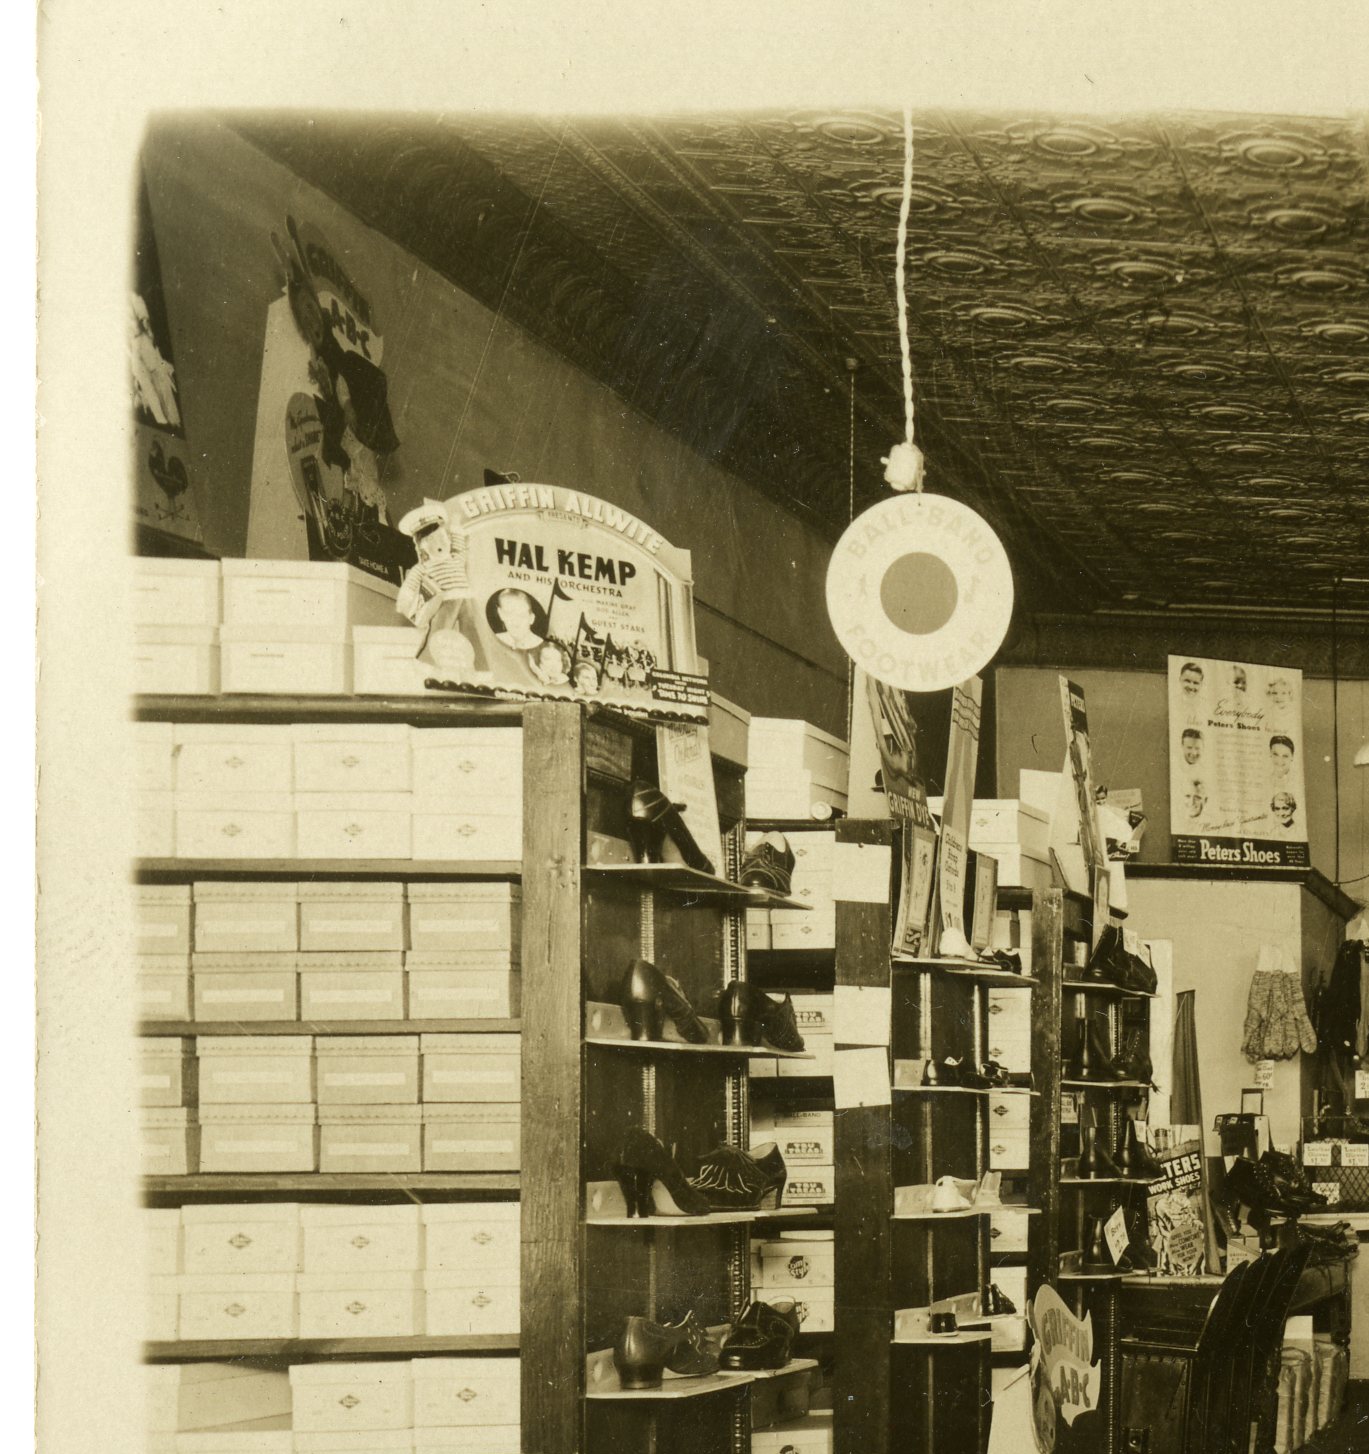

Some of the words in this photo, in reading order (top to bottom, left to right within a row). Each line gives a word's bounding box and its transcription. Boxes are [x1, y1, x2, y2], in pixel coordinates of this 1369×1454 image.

[462, 487, 556, 518] GRIFFIN
[565, 493, 664, 555] ALLWITE
[495, 537, 549, 572] HAL
[557, 548, 637, 586] KEMP
[507, 570, 531, 582] AND
[536, 574, 553, 586] HIS
[560, 578, 624, 598] ORCHESTRA
[1207, 719, 1234, 729] Peters
[1237, 722, 1261, 732] Shoes
[1213, 699, 1266, 728] Everybody
[888, 791, 916, 820] GRIFFIN
[1200, 838, 1241, 861] Peters
[1243, 840, 1281, 864] Shoes
[1158, 1152, 1201, 1179] TERS
[1148, 1181, 1173, 1195] WORK
[1175, 1171, 1201, 1189] SHOES
[1041, 1307, 1090, 1363] GRIFFIN
